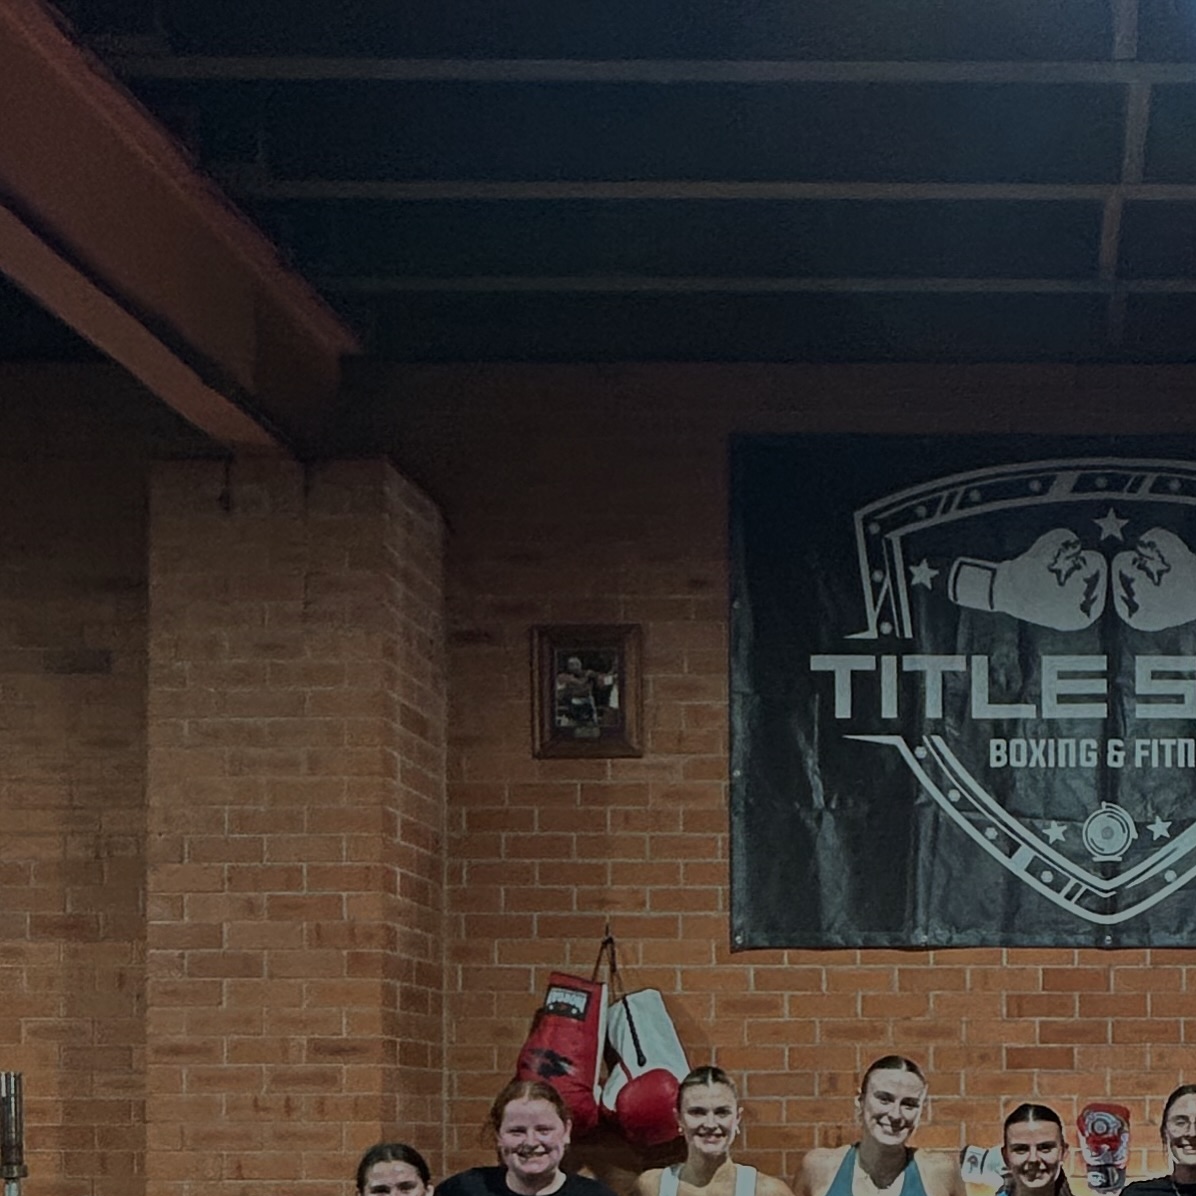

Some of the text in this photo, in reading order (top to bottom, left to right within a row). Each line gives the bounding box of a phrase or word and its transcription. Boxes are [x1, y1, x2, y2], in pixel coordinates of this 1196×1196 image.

[810, 655, 1108, 719] TITLE
[989, 738, 1098, 769] BOXING
[1107, 738, 1127, 769] &
